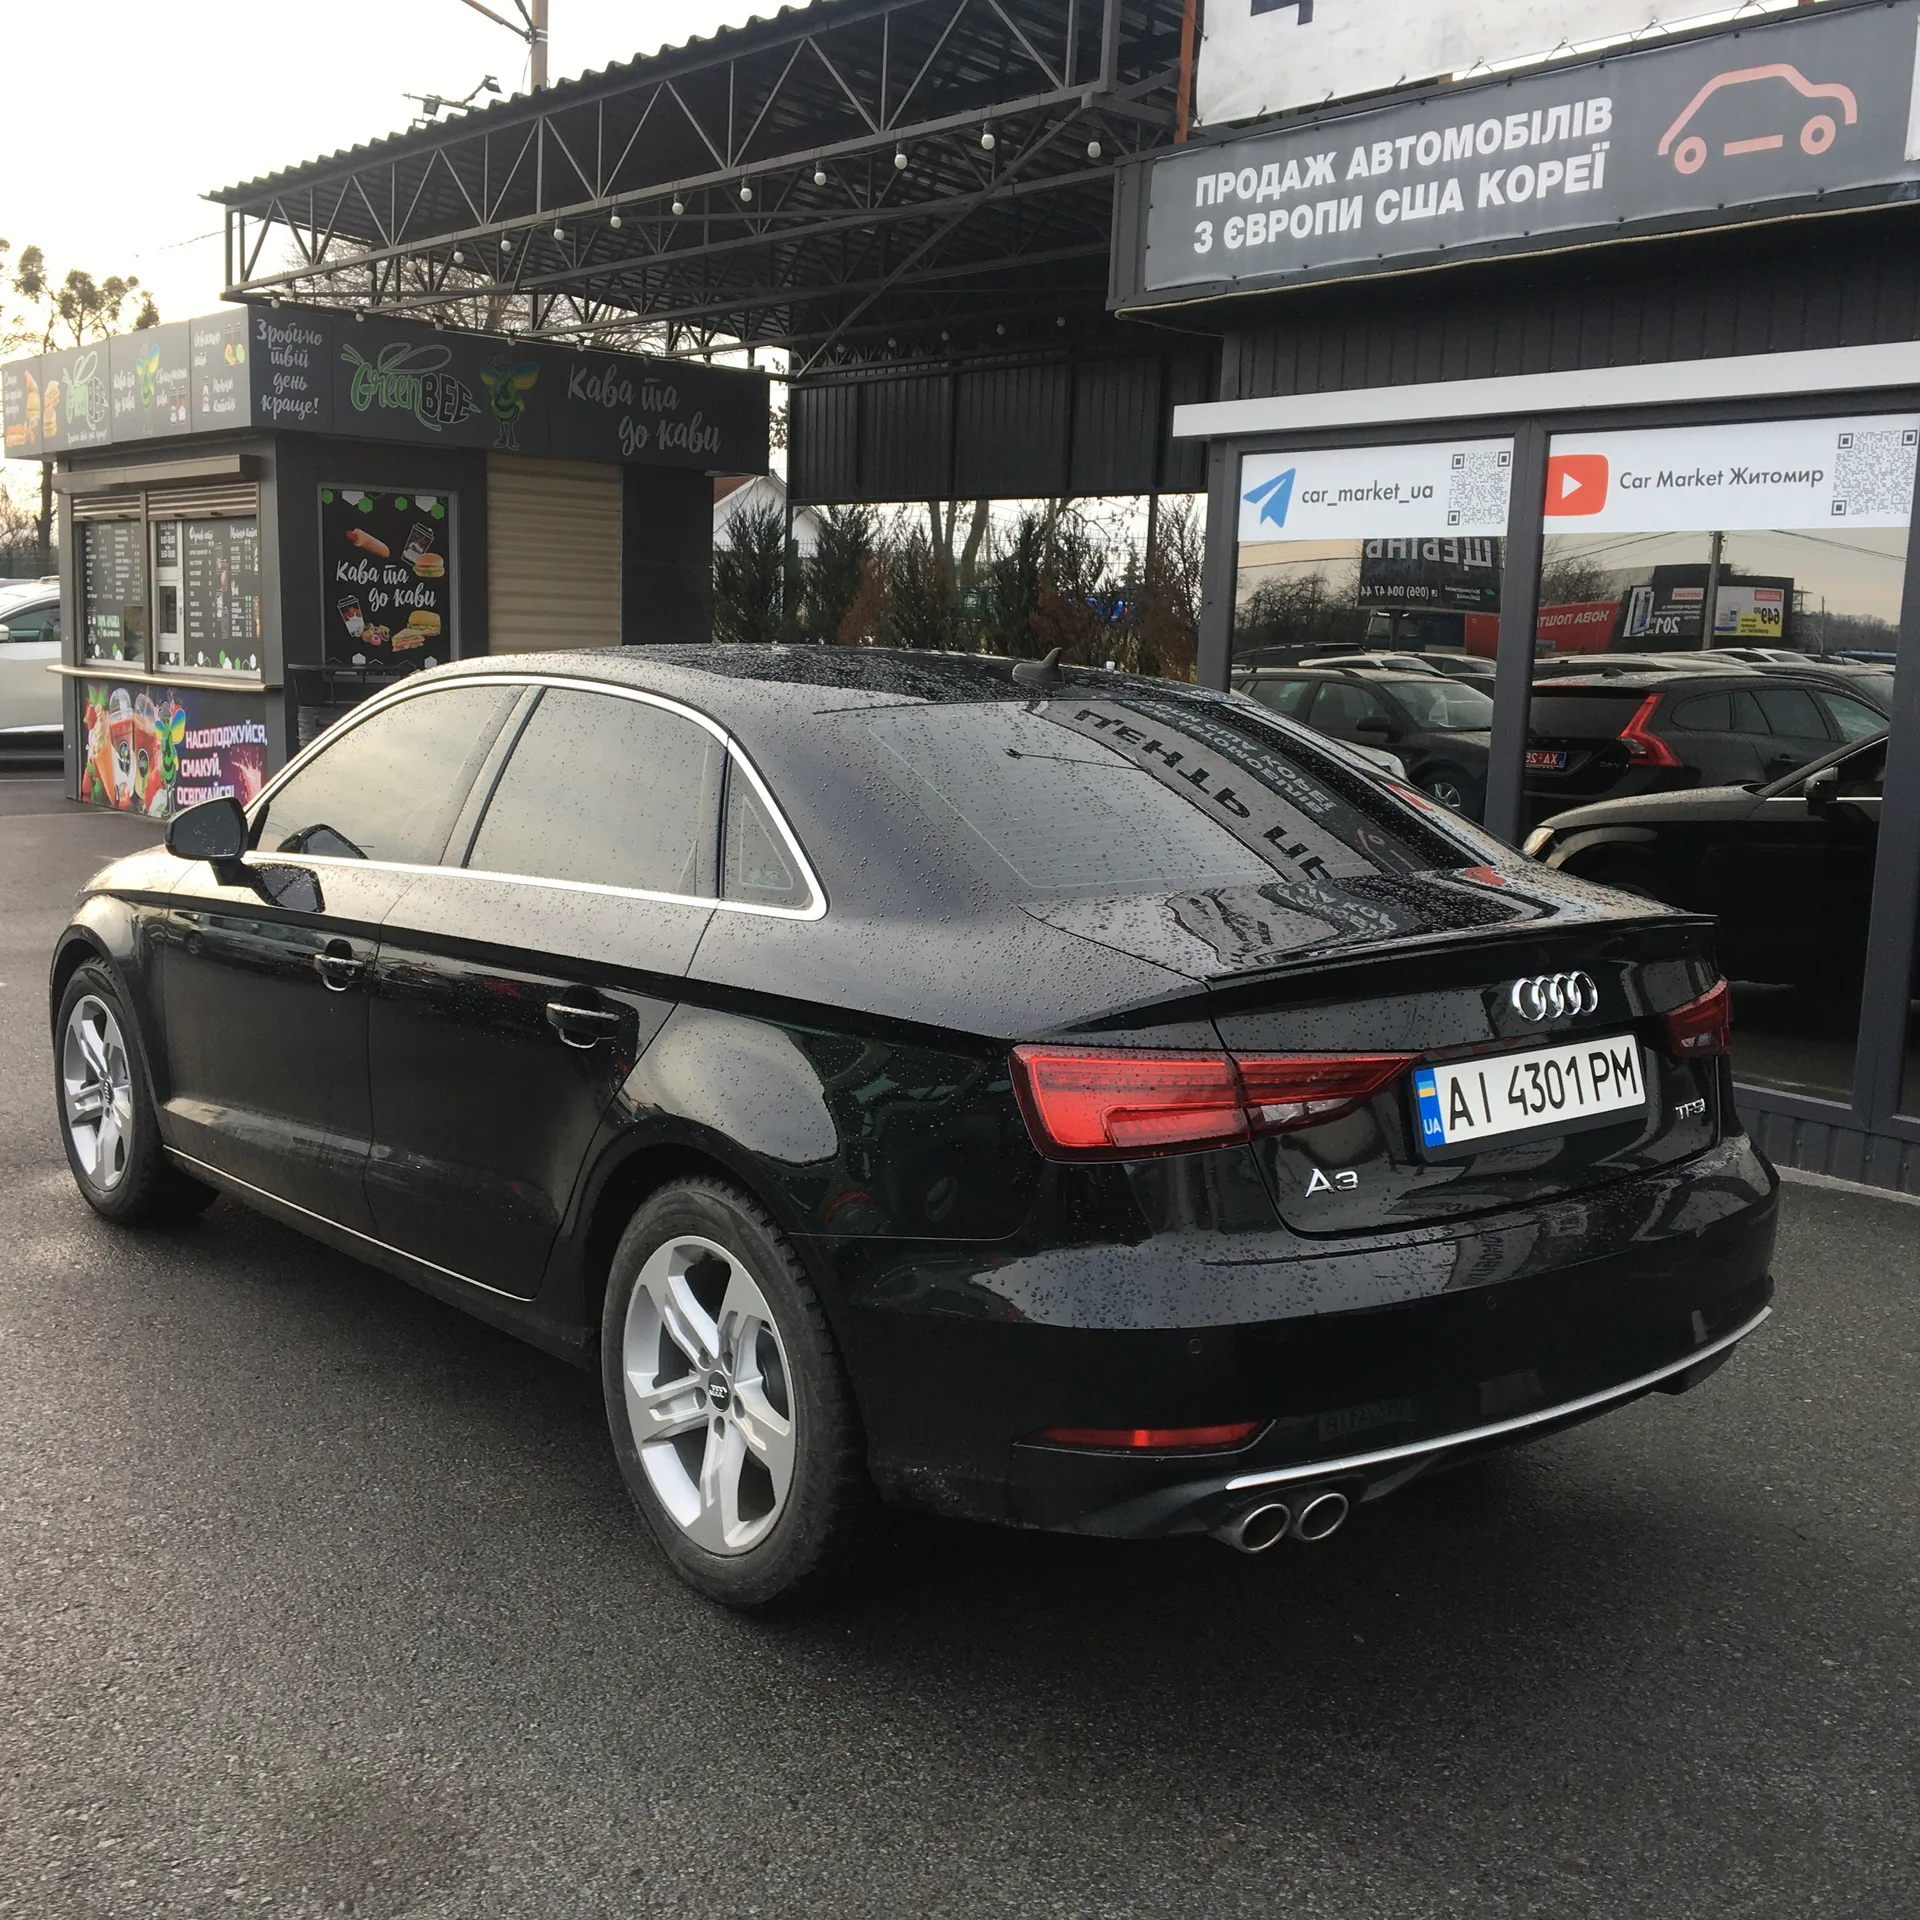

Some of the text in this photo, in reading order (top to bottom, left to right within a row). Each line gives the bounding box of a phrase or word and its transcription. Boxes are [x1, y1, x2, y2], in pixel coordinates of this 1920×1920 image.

[1196, 97, 1613, 206] ПРОДАЖ АВТОМОБІЛІВ
[1194, 142, 1608, 254] З ЄВРОПИ США КОРЕЇ
[257, 318, 323, 349] Зробимо
[271, 345, 309, 368] твій
[273, 373, 308, 394] день
[567, 364, 680, 412] Кава та
[261, 394, 319, 420] краще!
[619, 411, 722, 456] до кави
[1619, 467, 1824, 490] Car Market Житомир
[1301, 480, 1434, 507] car_market_ua
[336, 558, 409, 585] Кава та
[368, 583, 437, 612] до кави
[185, 719, 268, 749] НАСОЛОДЖУЙСЯ,
[181, 752, 222, 778] СМАКУЙ,
[1449, 1046, 1640, 1131] AI 4301 PM
[1424, 1118, 1441, 1135] UA
[1304, 1167, 1358, 1198] A3
